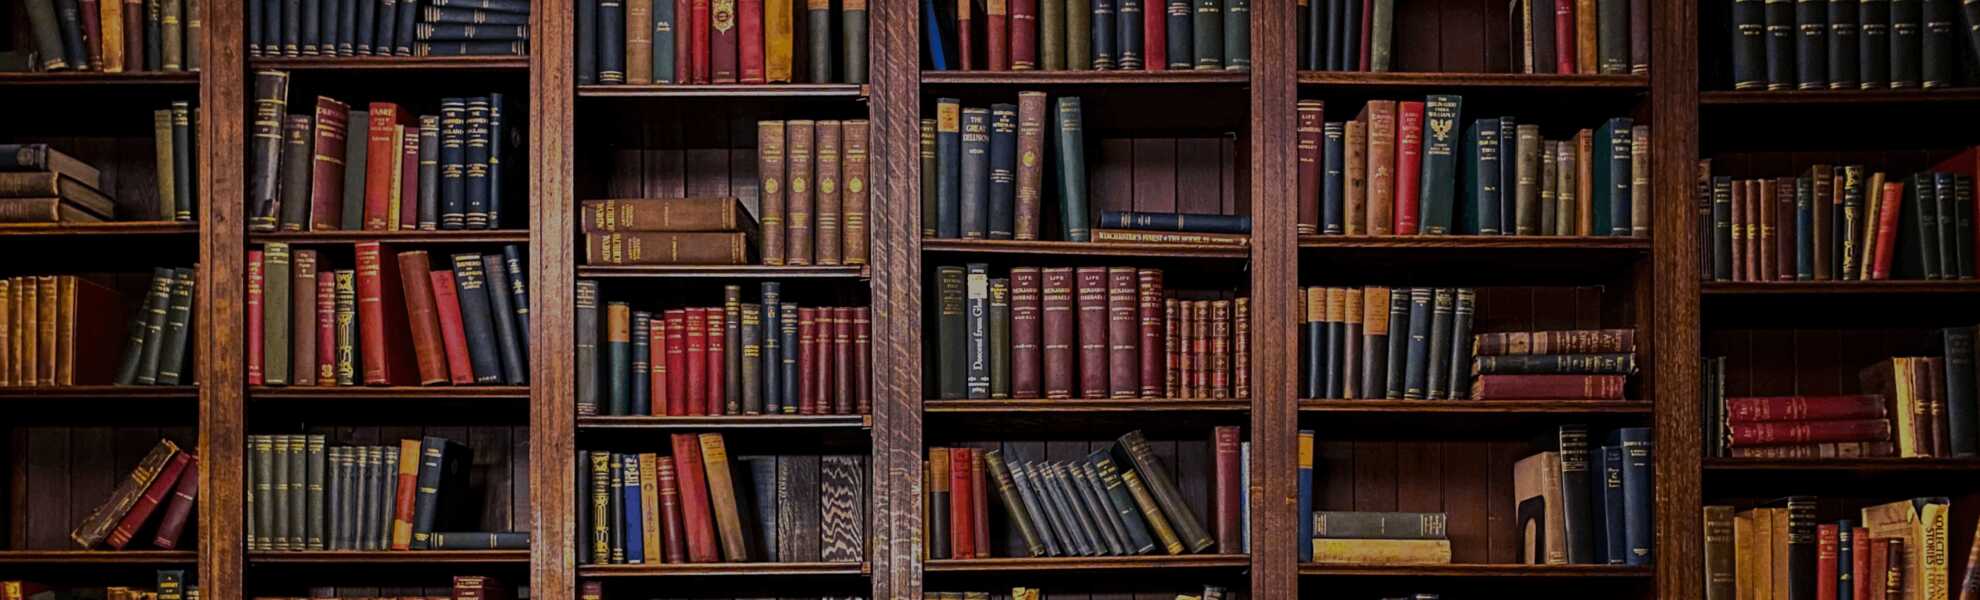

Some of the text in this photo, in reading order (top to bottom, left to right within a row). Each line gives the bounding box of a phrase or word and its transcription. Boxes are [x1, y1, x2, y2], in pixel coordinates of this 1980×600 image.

[973, 317, 982, 338] from
[972, 339, 982, 371] Descent
[1926, 528, 1935, 565] STORIES
[1936, 514, 1944, 565] COLLECTED
